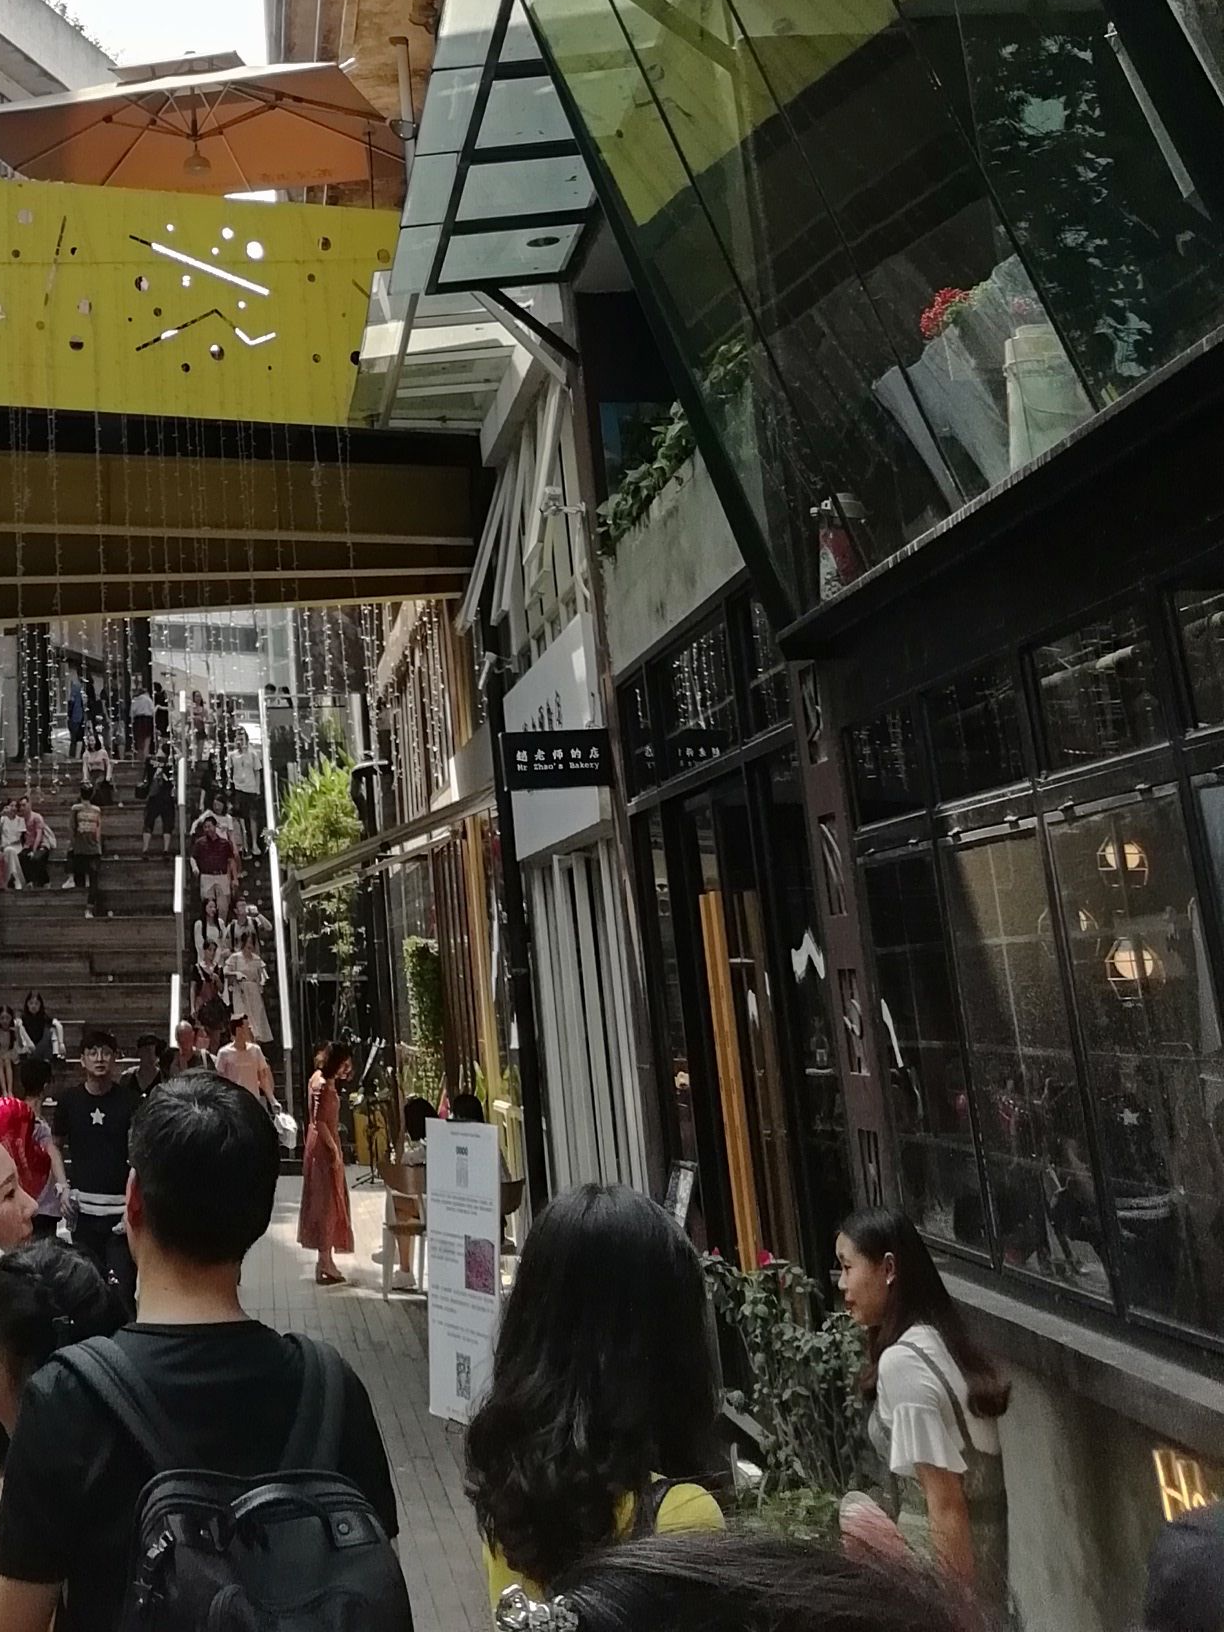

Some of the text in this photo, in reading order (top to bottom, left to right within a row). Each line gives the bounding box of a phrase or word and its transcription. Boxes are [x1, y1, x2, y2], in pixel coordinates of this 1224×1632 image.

[517, 761, 600, 771] Mr Zhao's Bakery
